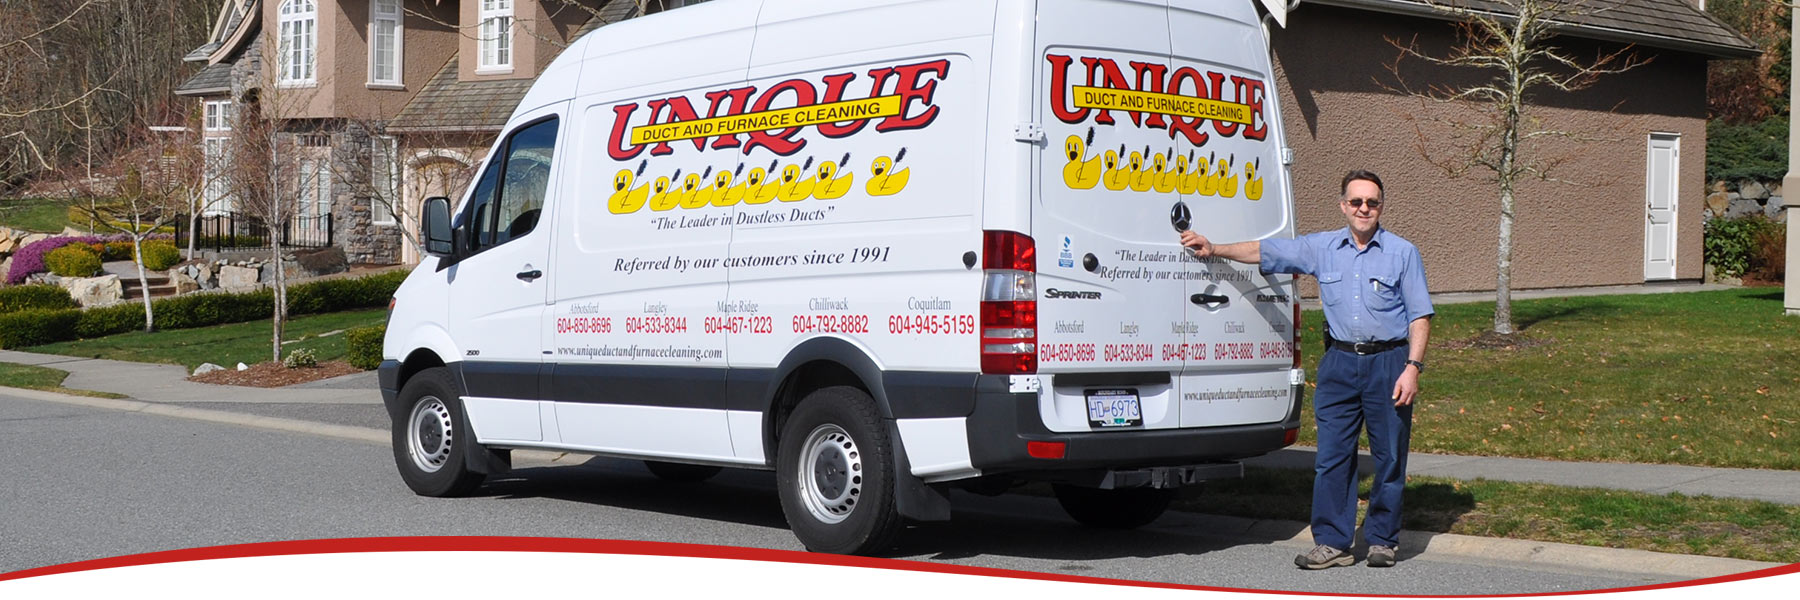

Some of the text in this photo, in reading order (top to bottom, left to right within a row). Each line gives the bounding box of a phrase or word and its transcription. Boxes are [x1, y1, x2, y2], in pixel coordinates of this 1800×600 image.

[607, 59, 950, 161] UNIQUE
[1046, 54, 1268, 148] UNIQUE
[1085, 92, 1243, 120] DUCT AND FURNACE CLEANING
[643, 101, 881, 141] DUCT AND FURNACE CLEANING
[680, 214, 718, 228] Leader
[721, 215, 733, 226] in
[736, 208, 785, 225] Dustless
[614, 246, 891, 275] Referred by our customers since 1991
[1138, 250, 1167, 262] Leader
[1169, 251, 1177, 263] in
[1100, 266, 1253, 283] Referred by our customers since 1991
[569, 302, 599, 315] Abbotsford
[643, 301, 668, 317] Langley
[717, 300, 759, 316] Maple Ridge
[809, 297, 849, 311] Chilliwack
[908, 296, 951, 314] Coquitlam
[557, 316, 612, 334] 604-850-8696
[625, 316, 687, 334] 604-533-8344
[704, 316, 773, 334] 604-467-1223
[792, 314, 869, 333] 604-792-8882
[888, 314, 975, 335] 604-945-5159
[1054, 320, 1085, 334] Abbotsford
[1120, 321, 1139, 337] Langley
[557, 344, 723, 361] www.uniqueductandfurnacecleaning.com
[1040, 343, 1096, 362] 604-850-8696
[1104, 343, 1153, 362] 604-533-8344
[1162, 343, 1207, 361] 604-467-1223
[1215, 343, 1254, 360] 604-792-8882
